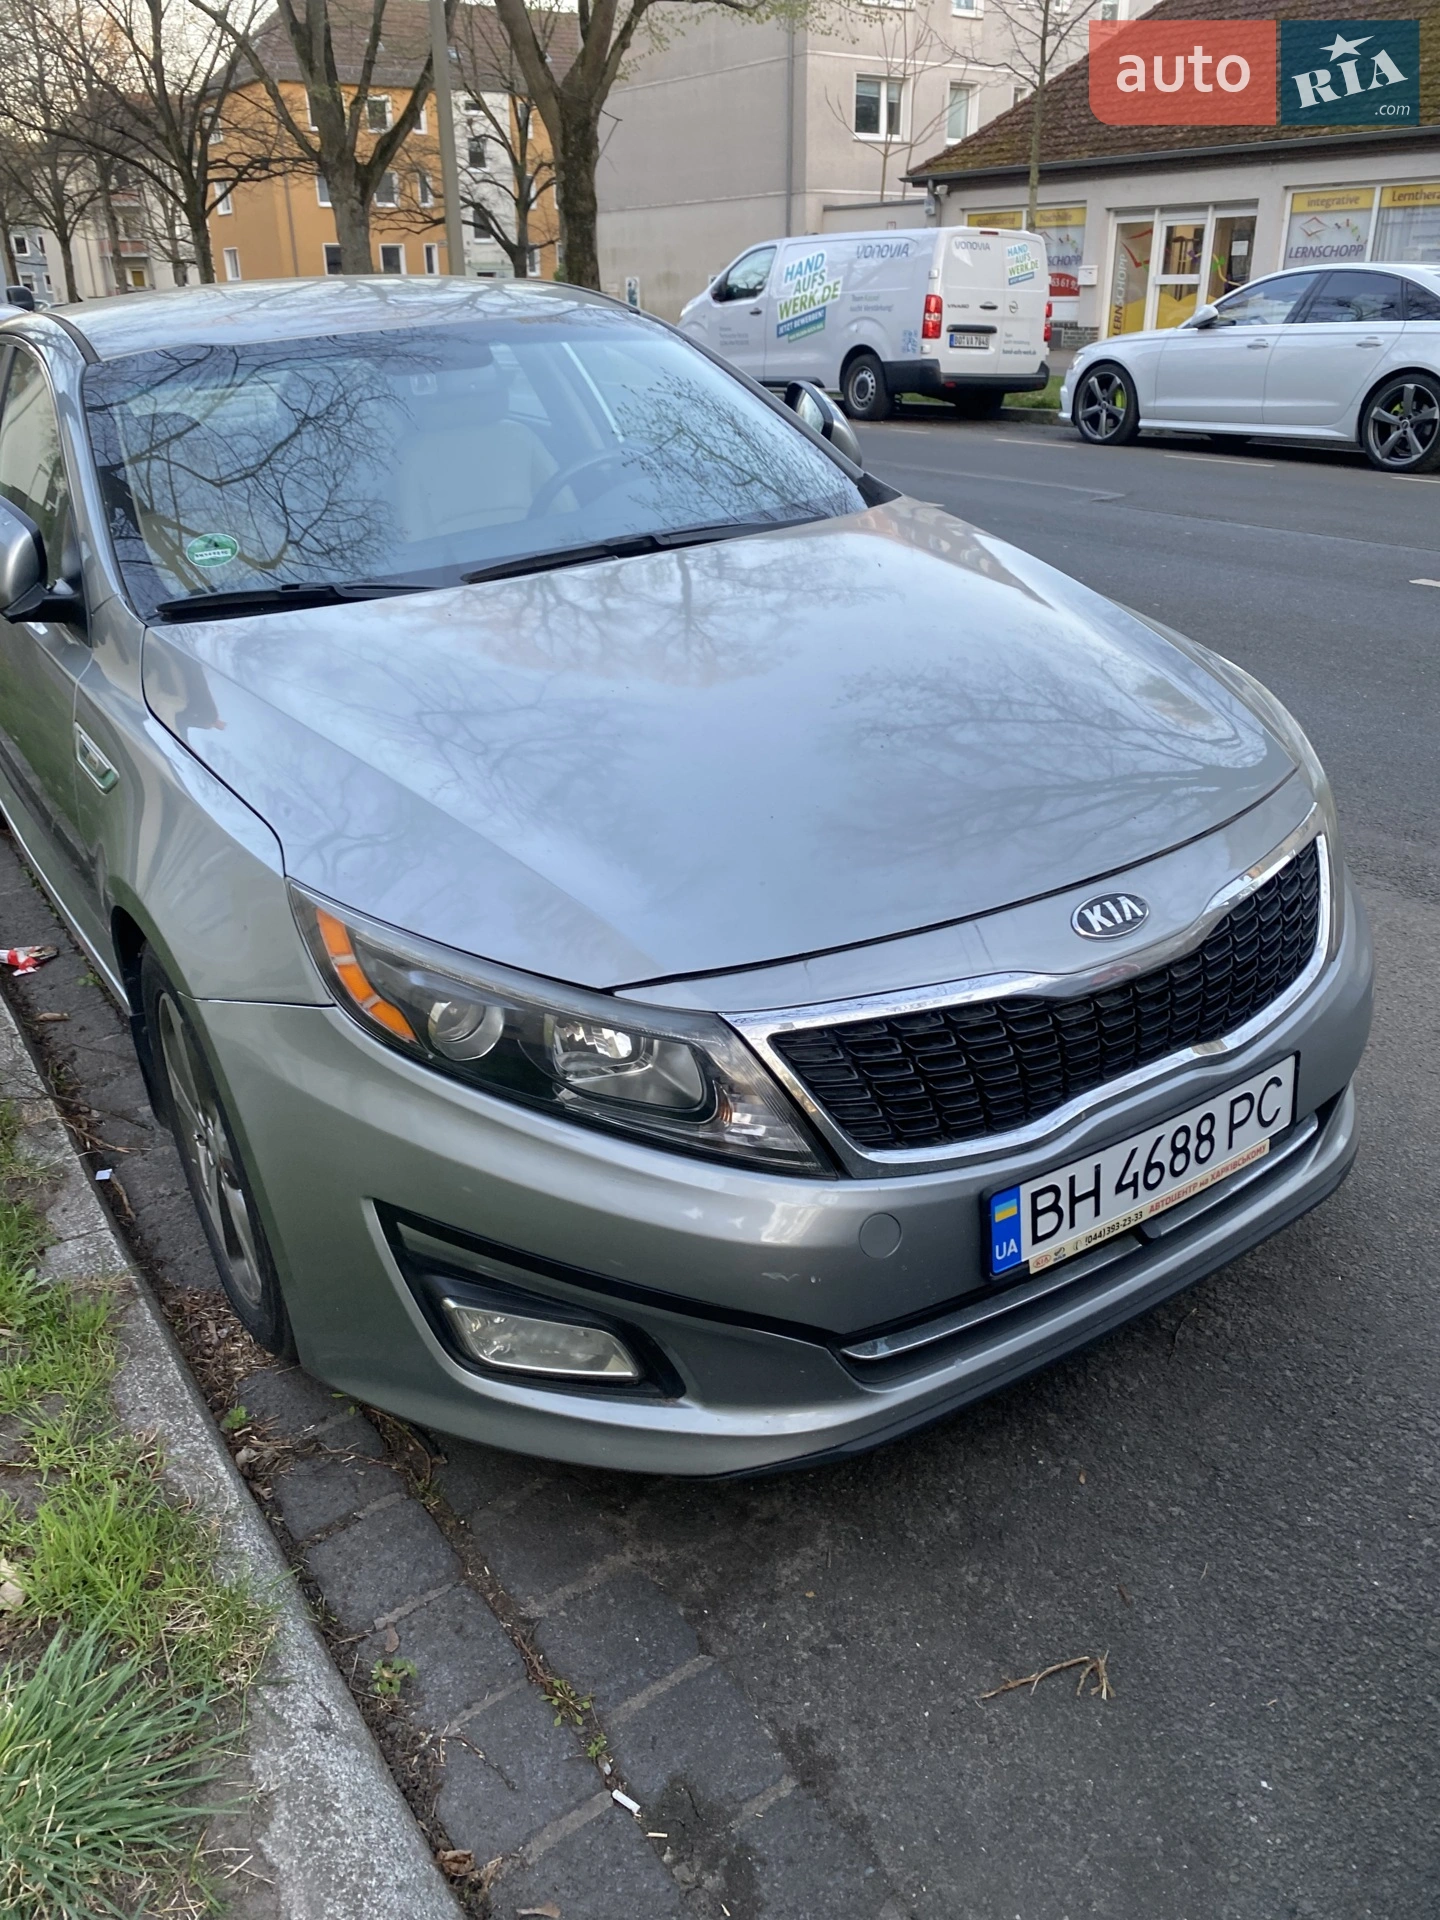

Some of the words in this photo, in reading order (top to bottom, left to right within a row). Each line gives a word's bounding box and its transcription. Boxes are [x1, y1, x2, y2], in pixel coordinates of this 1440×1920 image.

[1307, 194, 1361, 208] integrative
[856, 243, 910, 259] VONOVIA
[1007, 243, 1028, 257] HAND
[1015, 252, 1031, 263] AUFS
[1047, 254, 1082, 267] SCHOPP
[1289, 244, 1364, 259] LERNSCHOPP
[784, 252, 825, 283] HAND
[1008, 259, 1039, 276] WERK.DE
[793, 269, 826, 296] AUFS
[1112, 253, 1128, 336] LERNSCHOPP
[778, 279, 841, 321] WERK.DE
[1081, 895, 1144, 932] KIA
[1030, 1163, 1101, 1246] BH
[1114, 1111, 1216, 1200] 4688
[1227, 1075, 1283, 1151] PC
[1148, 1182, 1198, 1214] АВТОЦЕНТР
[1210, 1144, 1267, 1181] ХАРКІВСЬКОМУ
[995, 1237, 1019, 1261] UA
